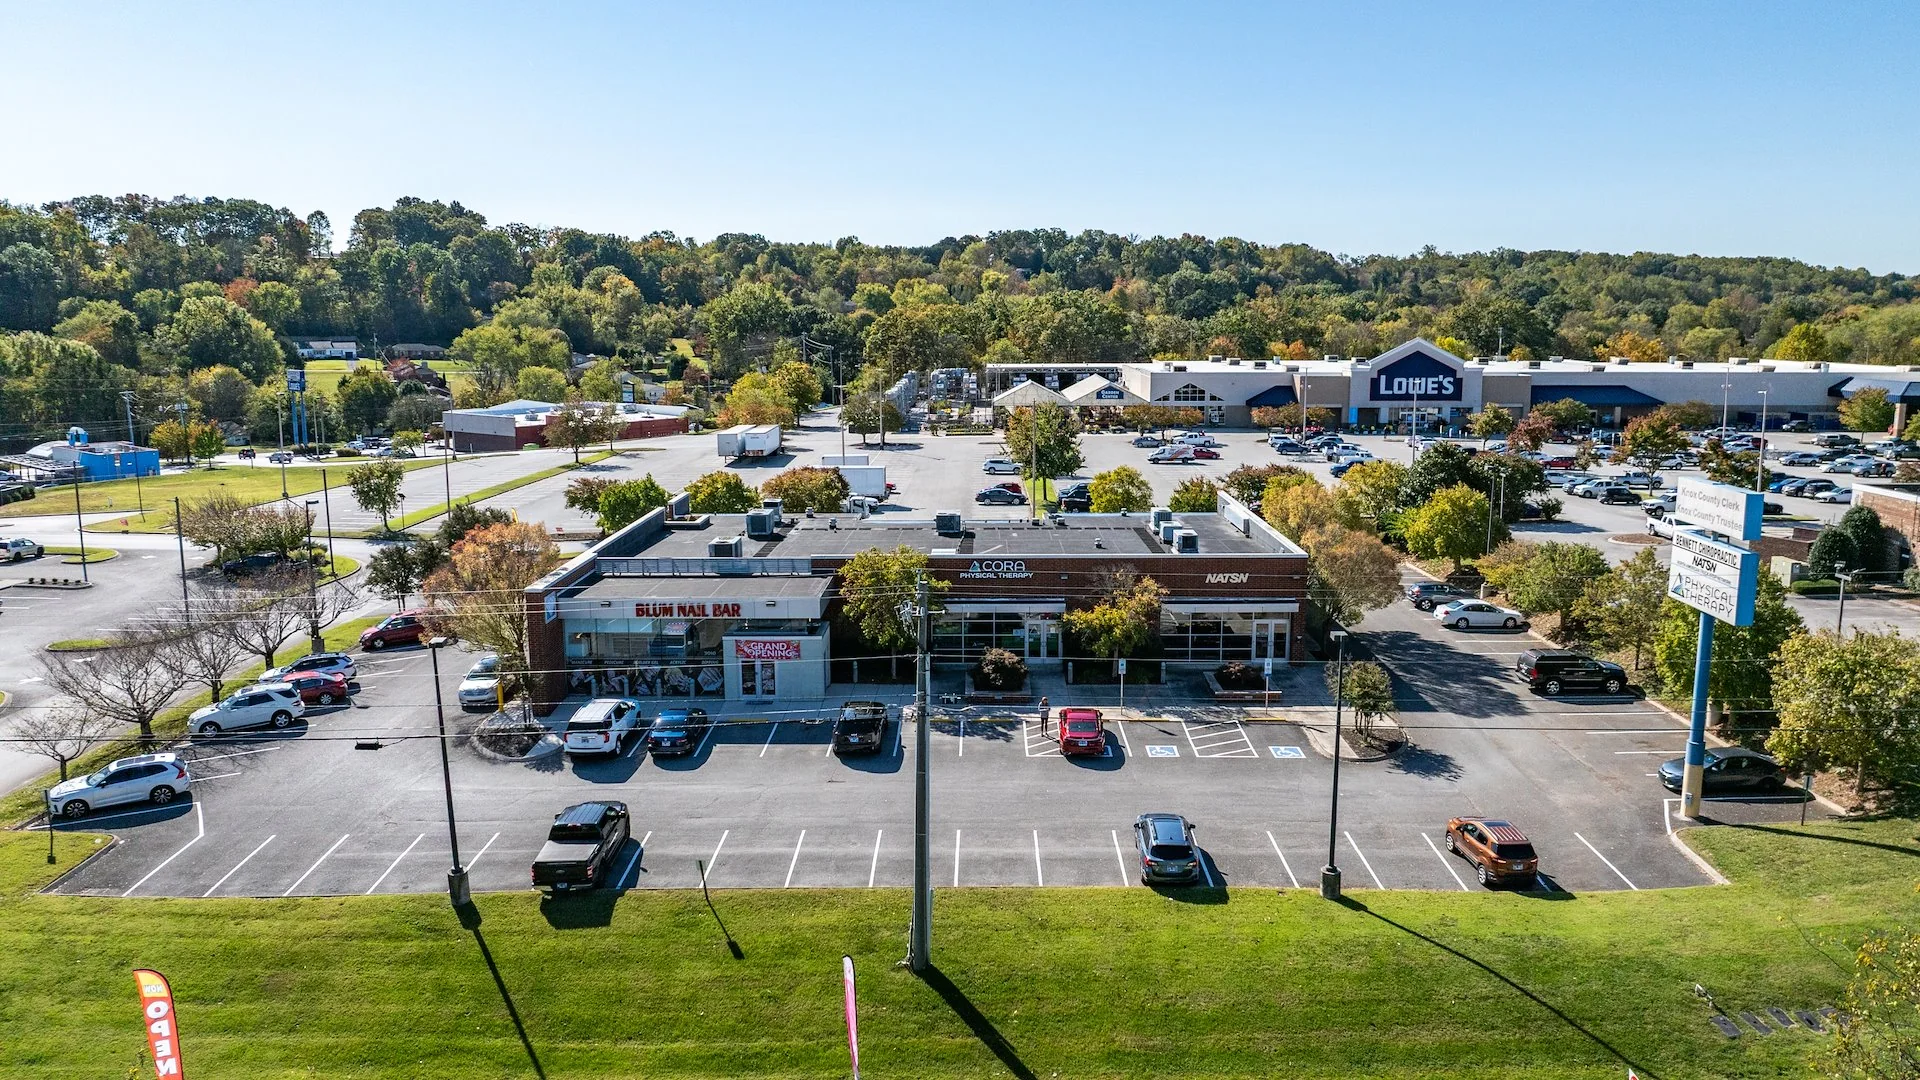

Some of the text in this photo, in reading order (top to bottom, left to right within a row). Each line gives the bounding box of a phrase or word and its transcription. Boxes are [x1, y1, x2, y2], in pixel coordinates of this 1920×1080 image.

[1380, 375, 1454, 394] LOWE'S
[1681, 486, 1740, 512] Knox County Clerk
[1677, 504, 1742, 532] Knox County Trustee
[1676, 534, 1737, 566] BENNETT CHIROPRACTIC
[982, 560, 1026, 572] CORA
[1692, 555, 1717, 573] NATSN
[1205, 573, 1249, 583] NATSN
[1684, 576, 1734, 607] PHYSICAL
[635, 603, 741, 617] BLUM NAIL BAR
[1685, 587, 1733, 618] THERAPY
[747, 649, 793, 657] OPENING
[751, 642, 787, 651] GRAND
